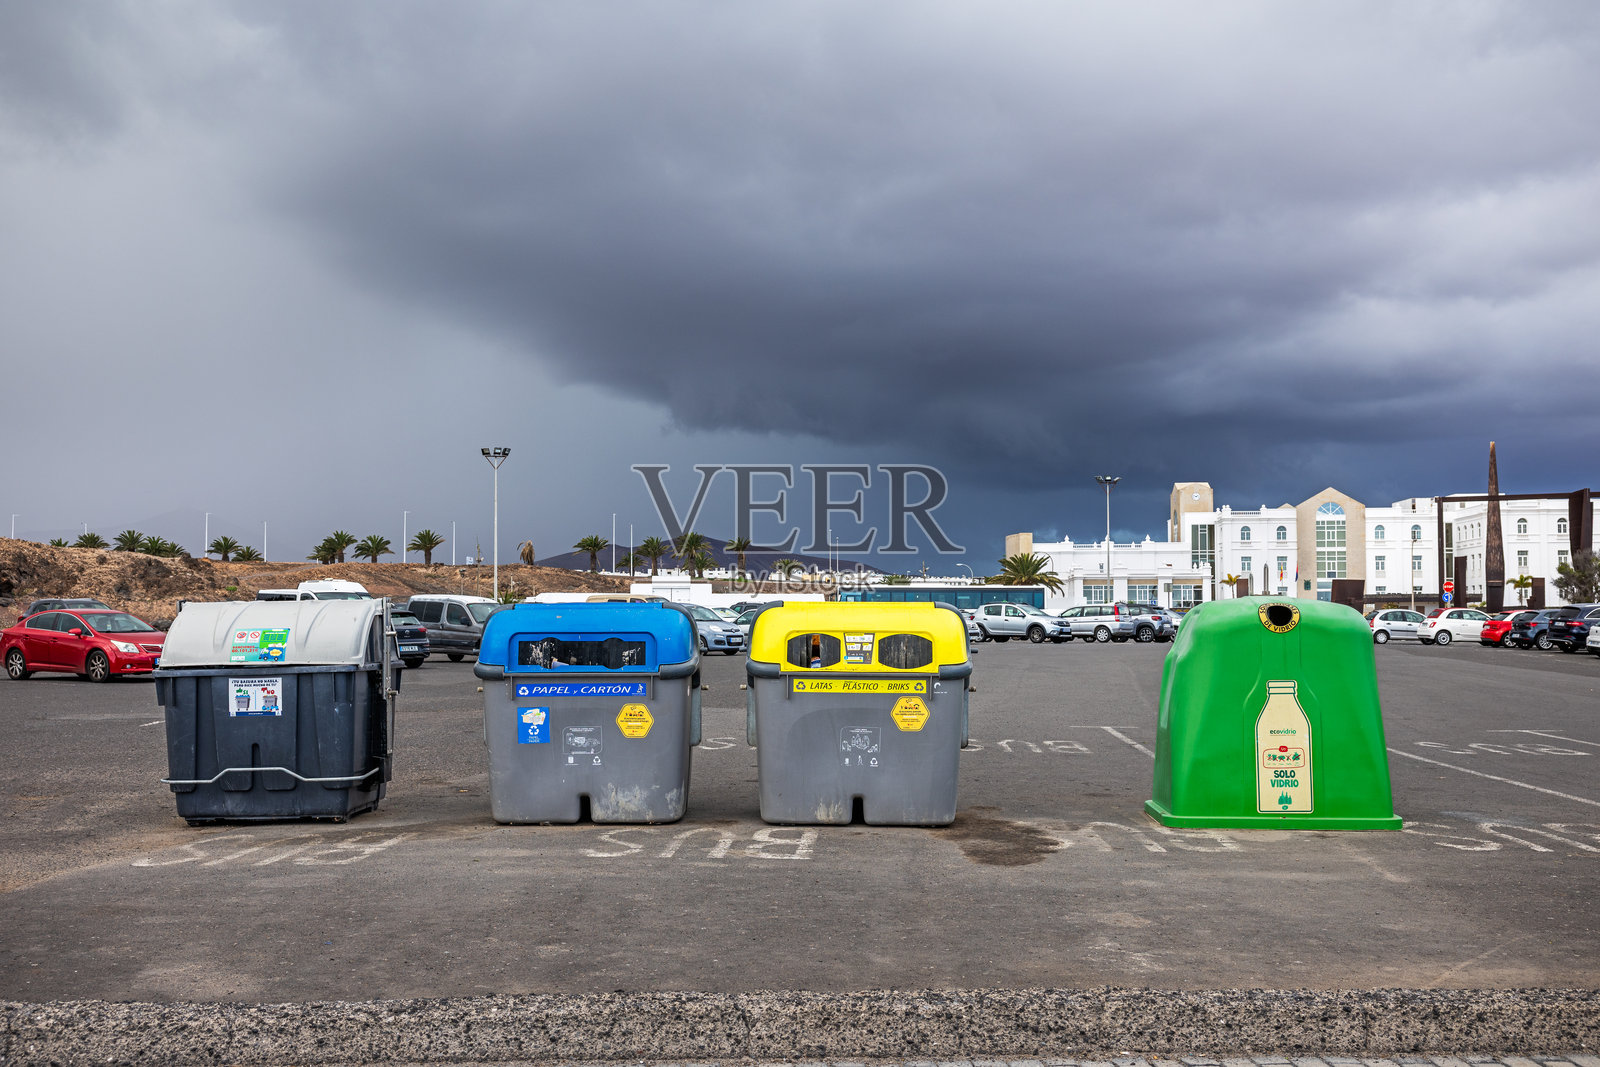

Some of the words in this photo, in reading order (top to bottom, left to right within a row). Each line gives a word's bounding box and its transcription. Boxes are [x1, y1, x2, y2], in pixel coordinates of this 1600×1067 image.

[1264, 620, 1273, 629] DE
[1273, 620, 1297, 632] VIDRIO
[532, 686, 570, 694] PAPEL
[580, 684, 631, 694] CARTÓN
[810, 682, 833, 690] LATAS
[842, 682, 879, 691] PLÁSTICO
[887, 683, 910, 691] BRIKS
[1273, 769, 1296, 778] SOLO
[1270, 779, 1299, 788] VIDRIO
[582, 826, 818, 861] BUS
